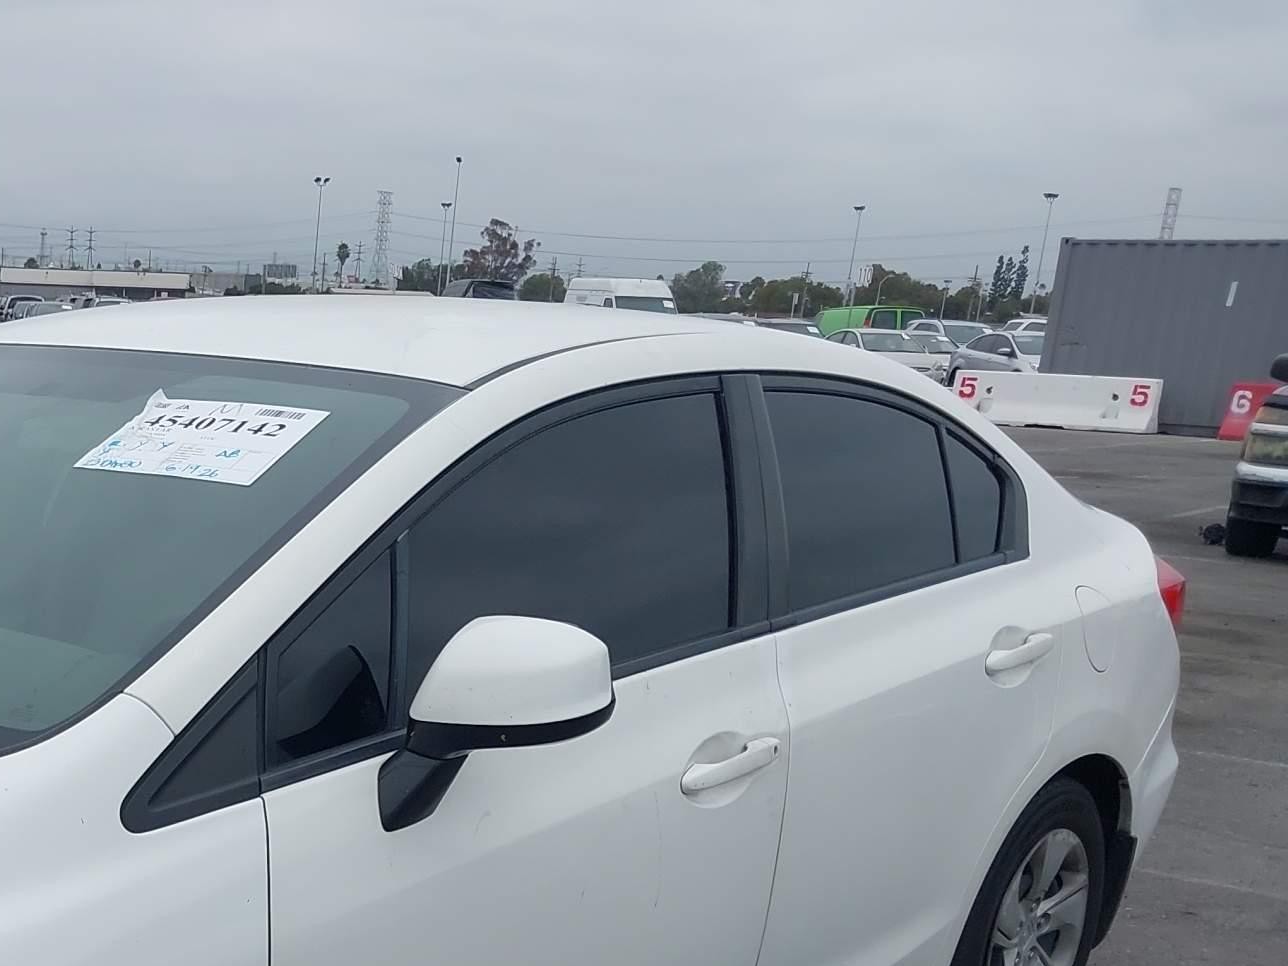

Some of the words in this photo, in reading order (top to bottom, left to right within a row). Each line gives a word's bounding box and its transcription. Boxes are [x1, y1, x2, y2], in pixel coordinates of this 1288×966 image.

[958, 377, 978, 398] 5
[1129, 384, 1151, 407] 5
[1231, 390, 1253, 414] 6
[144, 414, 287, 437] 45407142
